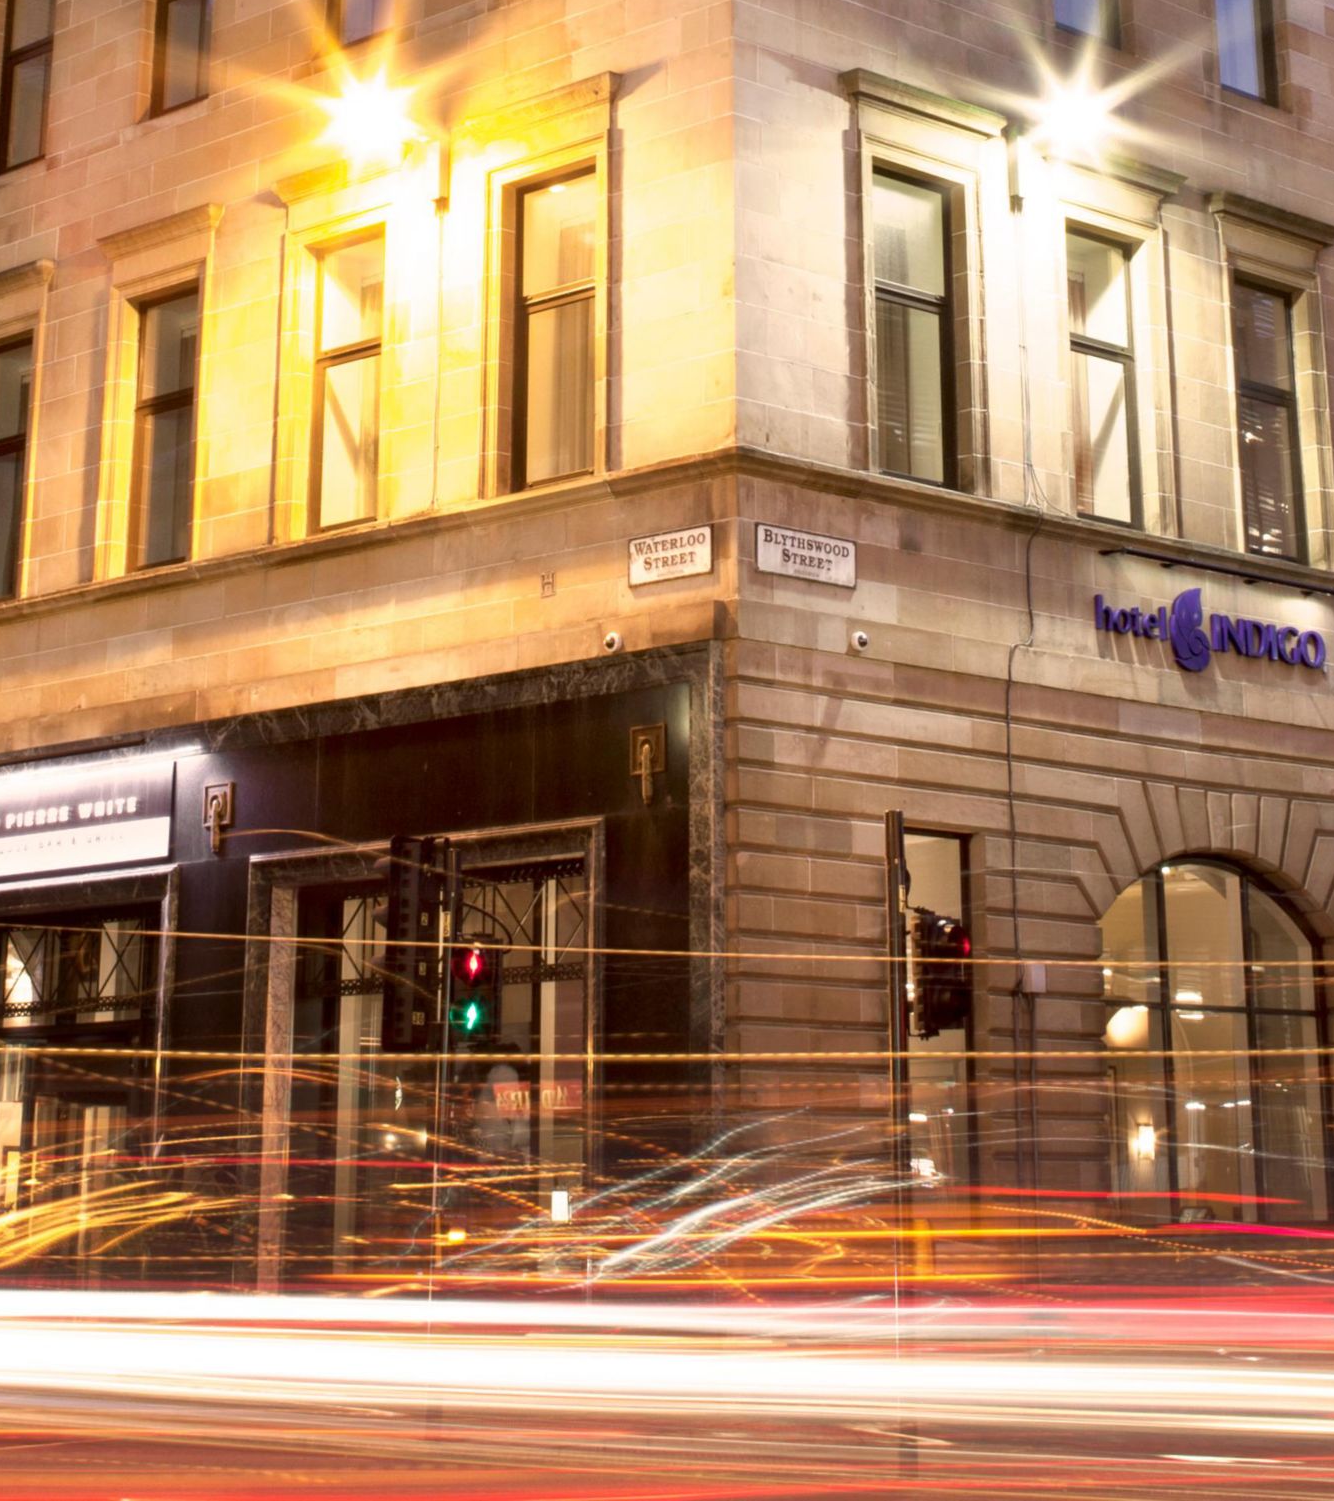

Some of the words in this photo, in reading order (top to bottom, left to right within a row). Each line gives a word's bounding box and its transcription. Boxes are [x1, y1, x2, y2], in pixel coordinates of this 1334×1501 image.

[634, 532, 706, 557] WATERLOO
[763, 528, 850, 558] BLYTHSWOOD
[643, 551, 696, 571] STREET
[782, 548, 833, 571] STREET
[1094, 594, 1167, 641] hotel
[1210, 613, 1327, 669] INDIGO
[5, 805, 69, 829] PIERRE
[78, 796, 138, 820] WHITE
